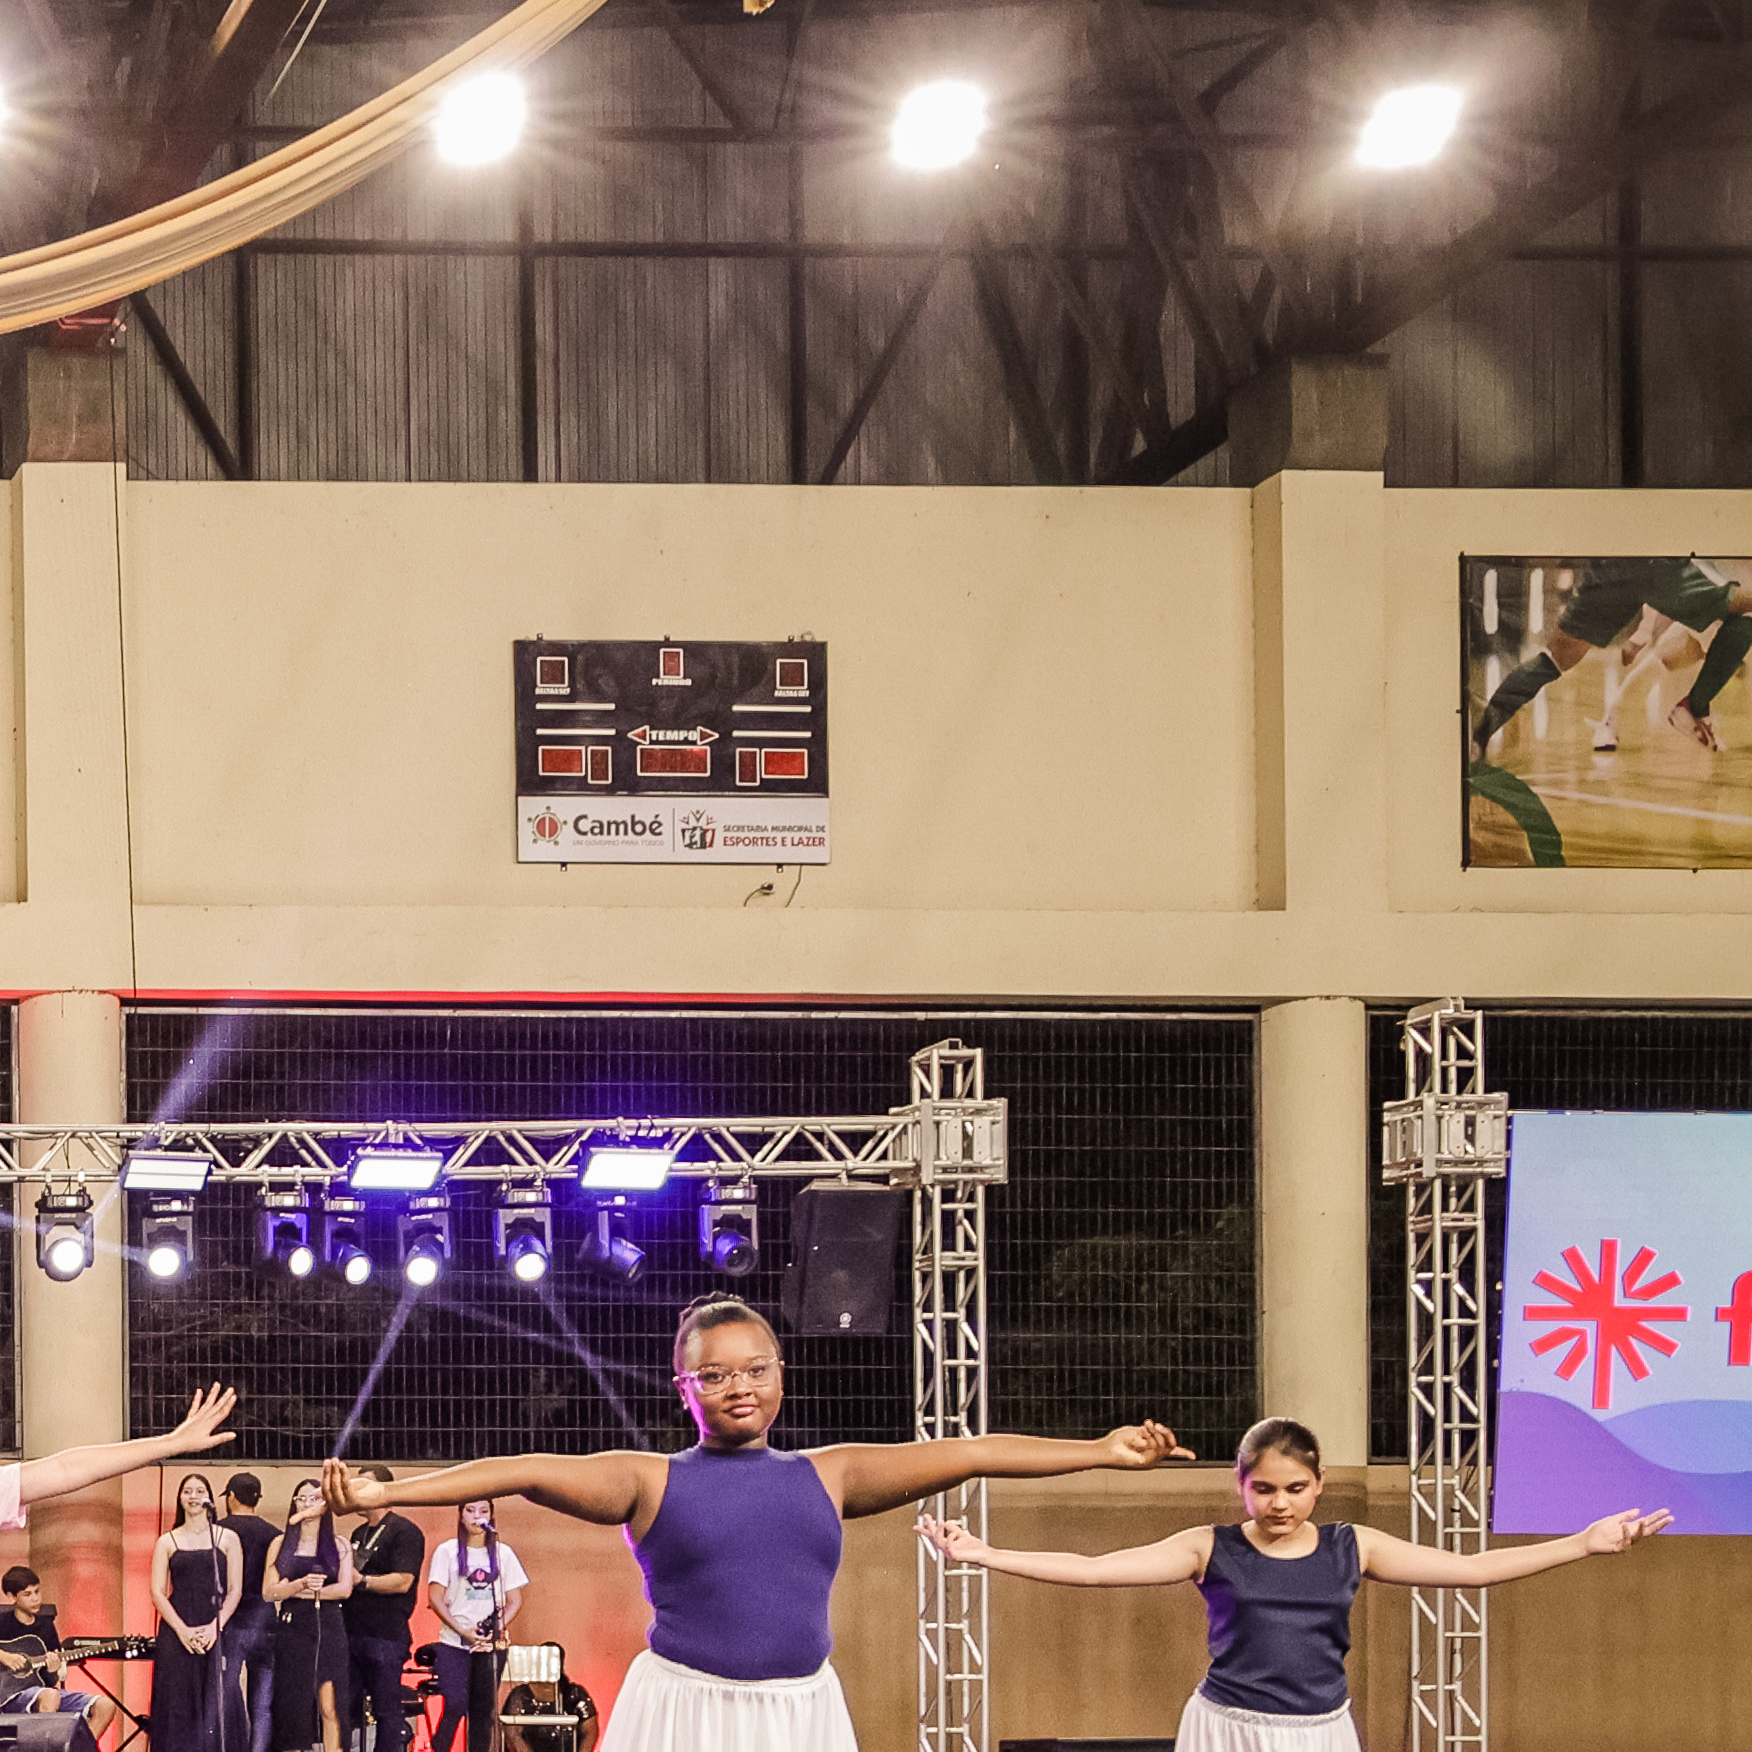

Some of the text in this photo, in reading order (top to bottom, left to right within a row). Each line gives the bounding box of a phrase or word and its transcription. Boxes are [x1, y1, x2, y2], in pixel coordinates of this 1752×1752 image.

[650, 730, 698, 741] TEMPO
[573, 813, 664, 836] Cambé
[723, 836, 826, 847] ESPORTES E LAZER
